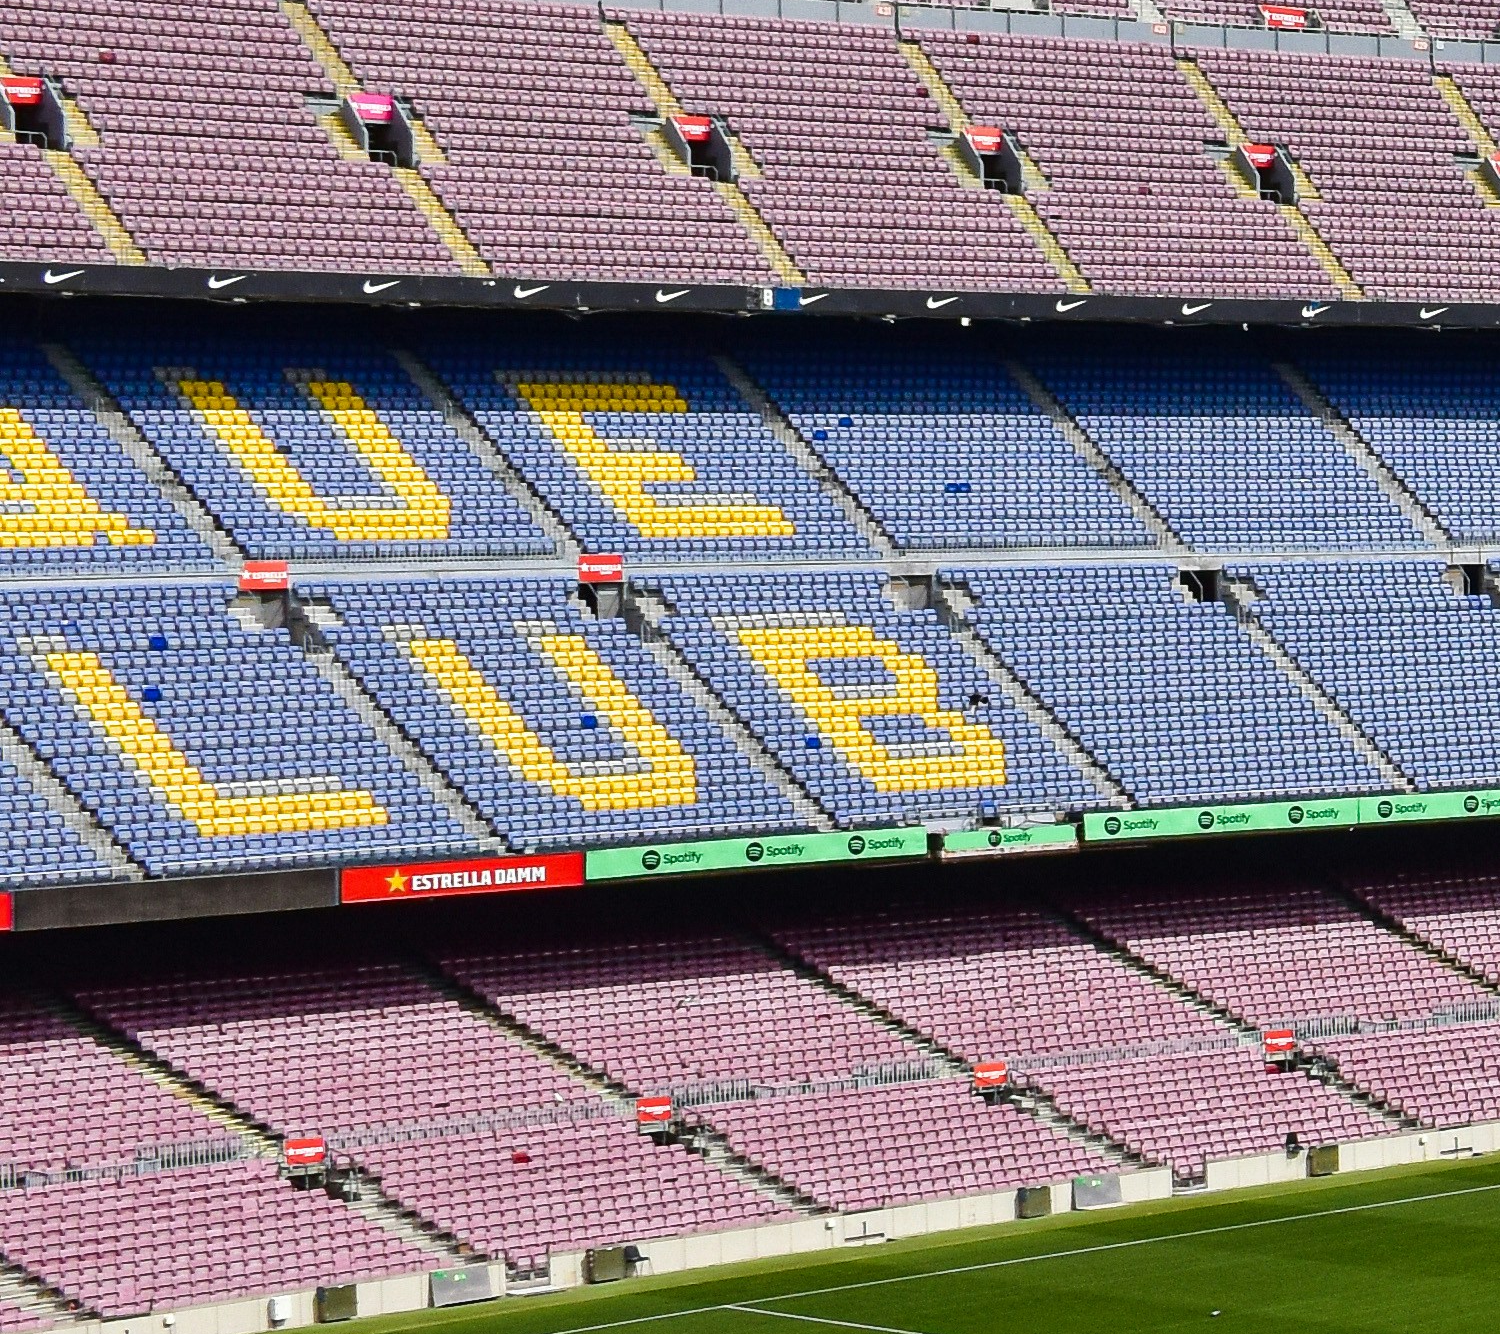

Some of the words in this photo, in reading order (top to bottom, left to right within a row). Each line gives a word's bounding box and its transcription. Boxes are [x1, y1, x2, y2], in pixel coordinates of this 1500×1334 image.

[763, 289, 774, 306] B
[1306, 806, 1340, 820] Spotify
[1394, 800, 1428, 815] Spotify
[1124, 818, 1159, 832] Spotify
[1216, 812, 1251, 825] Spotify
[868, 837, 905, 851] Spotify
[1003, 831, 1033, 844] Spotify
[766, 844, 805, 858] Spotify
[663, 851, 703, 866] Spotify
[411, 869, 491, 891] ESTRELLA
[495, 866, 546, 885] DAMM
